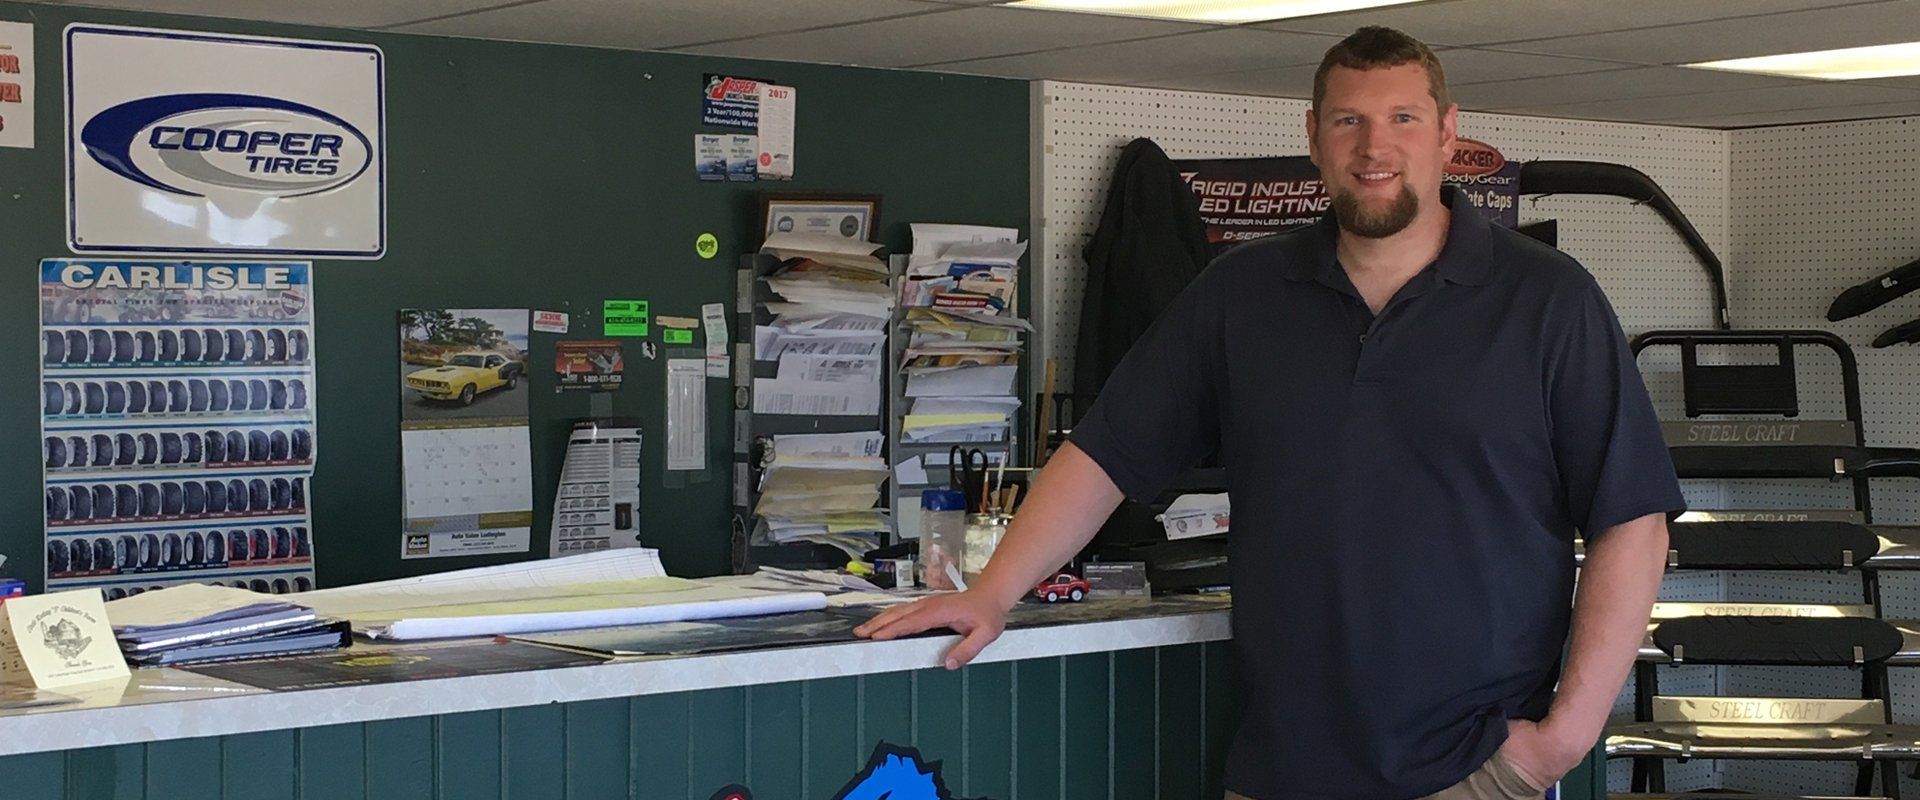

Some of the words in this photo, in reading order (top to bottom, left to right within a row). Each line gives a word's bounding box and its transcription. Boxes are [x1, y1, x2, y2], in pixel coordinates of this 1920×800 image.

[711, 77, 757, 99] JASPER
[768, 88, 788, 99] 2017
[704, 116, 741, 126] Nationwide
[149, 126, 344, 157] COOPER
[245, 155, 339, 176] TIRES
[1451, 149, 1494, 167] ACKER
[1442, 172, 1512, 186] BodyGear
[1192, 181, 1247, 197] RIGID
[1235, 197, 1331, 214] LIGHTING
[1462, 189, 1484, 208] ate
[1487, 190, 1512, 211] Caps
[1201, 217, 1219, 225] THE
[1220, 218, 1254, 226] LEADER
[1281, 217, 1314, 226] LIGHTING
[60, 264, 291, 291] CARLISLE
[1688, 424, 1741, 442] STEEL
[1745, 424, 1801, 442] CRAFT
[1710, 701, 1764, 719] STEEL
[1769, 701, 1826, 719] CRAFT
